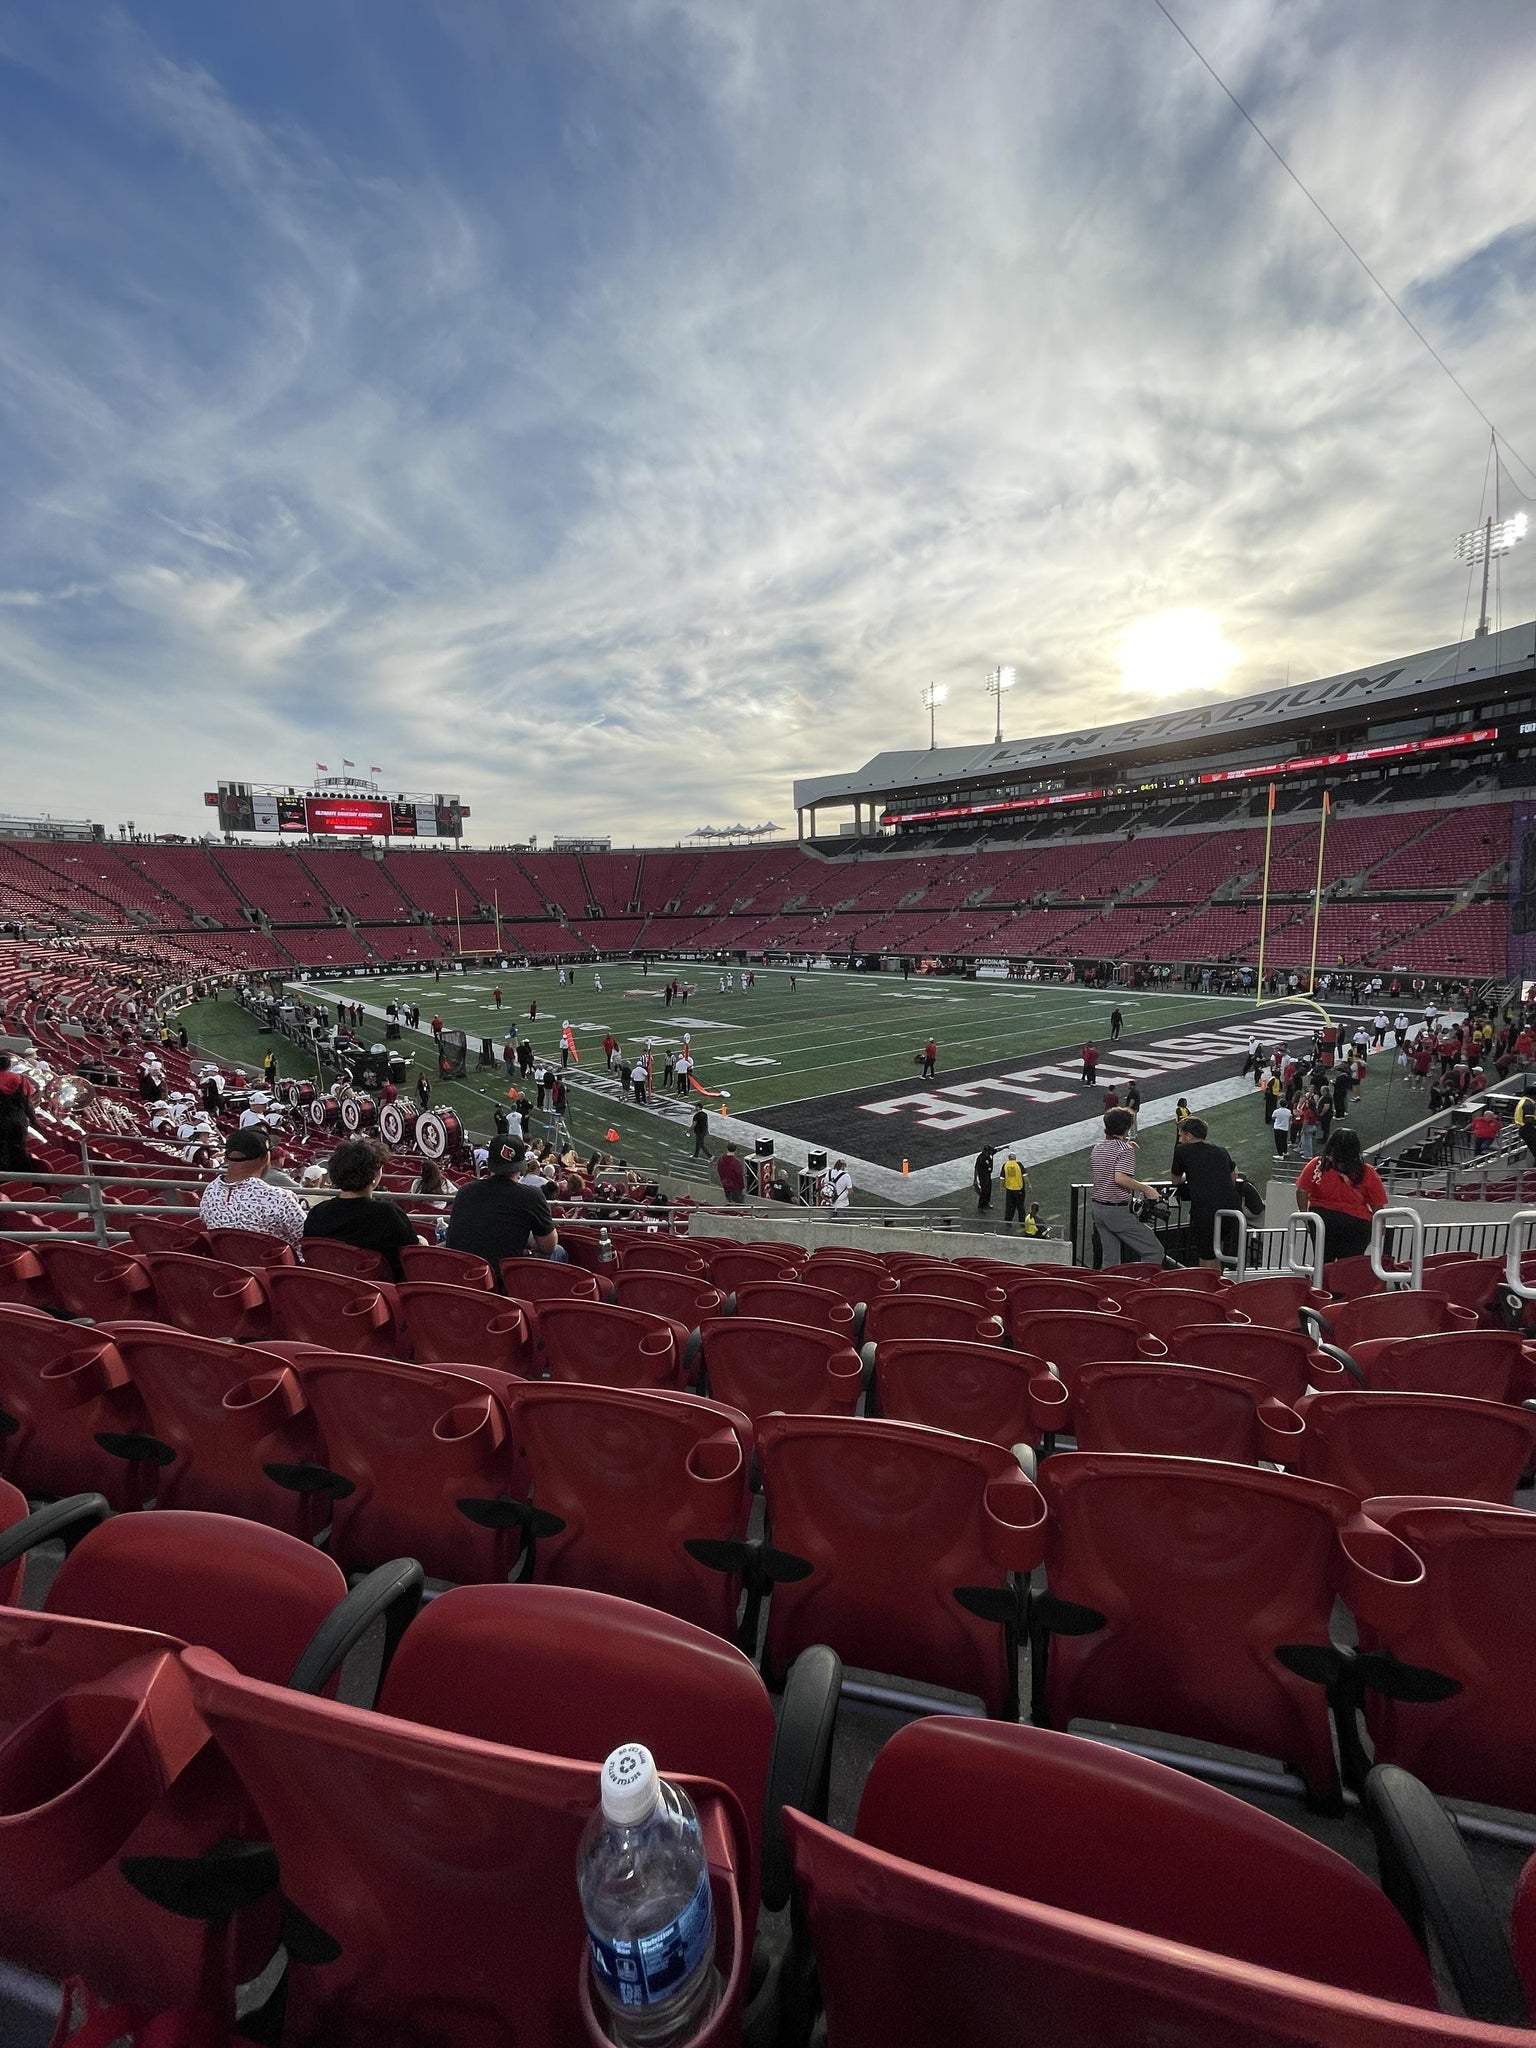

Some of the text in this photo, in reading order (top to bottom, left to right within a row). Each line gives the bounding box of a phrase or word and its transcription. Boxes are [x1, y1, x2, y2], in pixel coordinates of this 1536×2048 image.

[991, 668, 1406, 761] L&N STADIUM
[616, 1771, 641, 1785] RECYCLE
